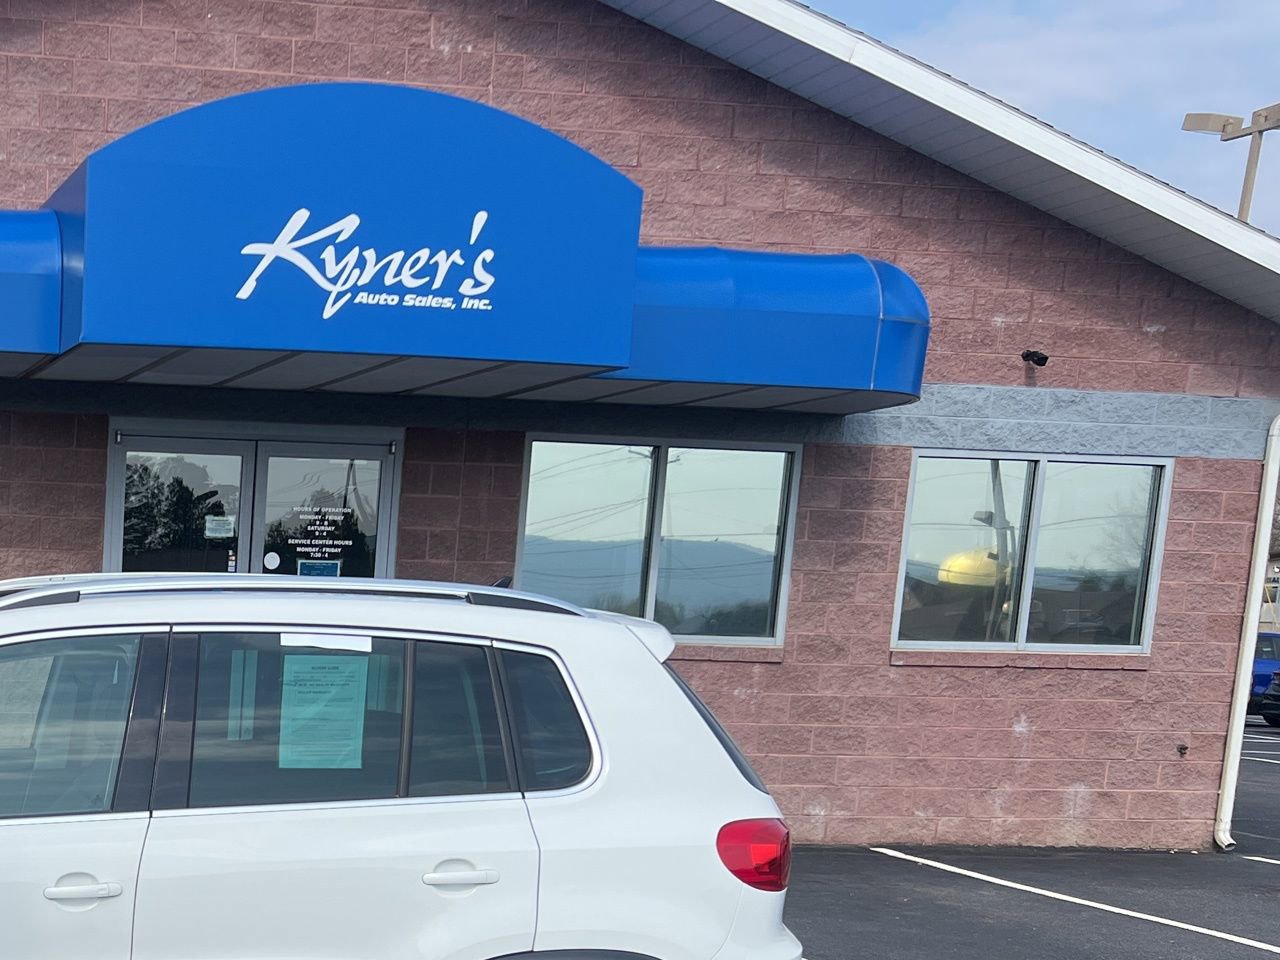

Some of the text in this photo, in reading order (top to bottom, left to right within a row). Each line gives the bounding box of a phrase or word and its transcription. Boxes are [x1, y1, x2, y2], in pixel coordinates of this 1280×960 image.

[235, 207, 496, 320] Kyner's
[353, 291, 494, 310] Auto Sales, Inc.
